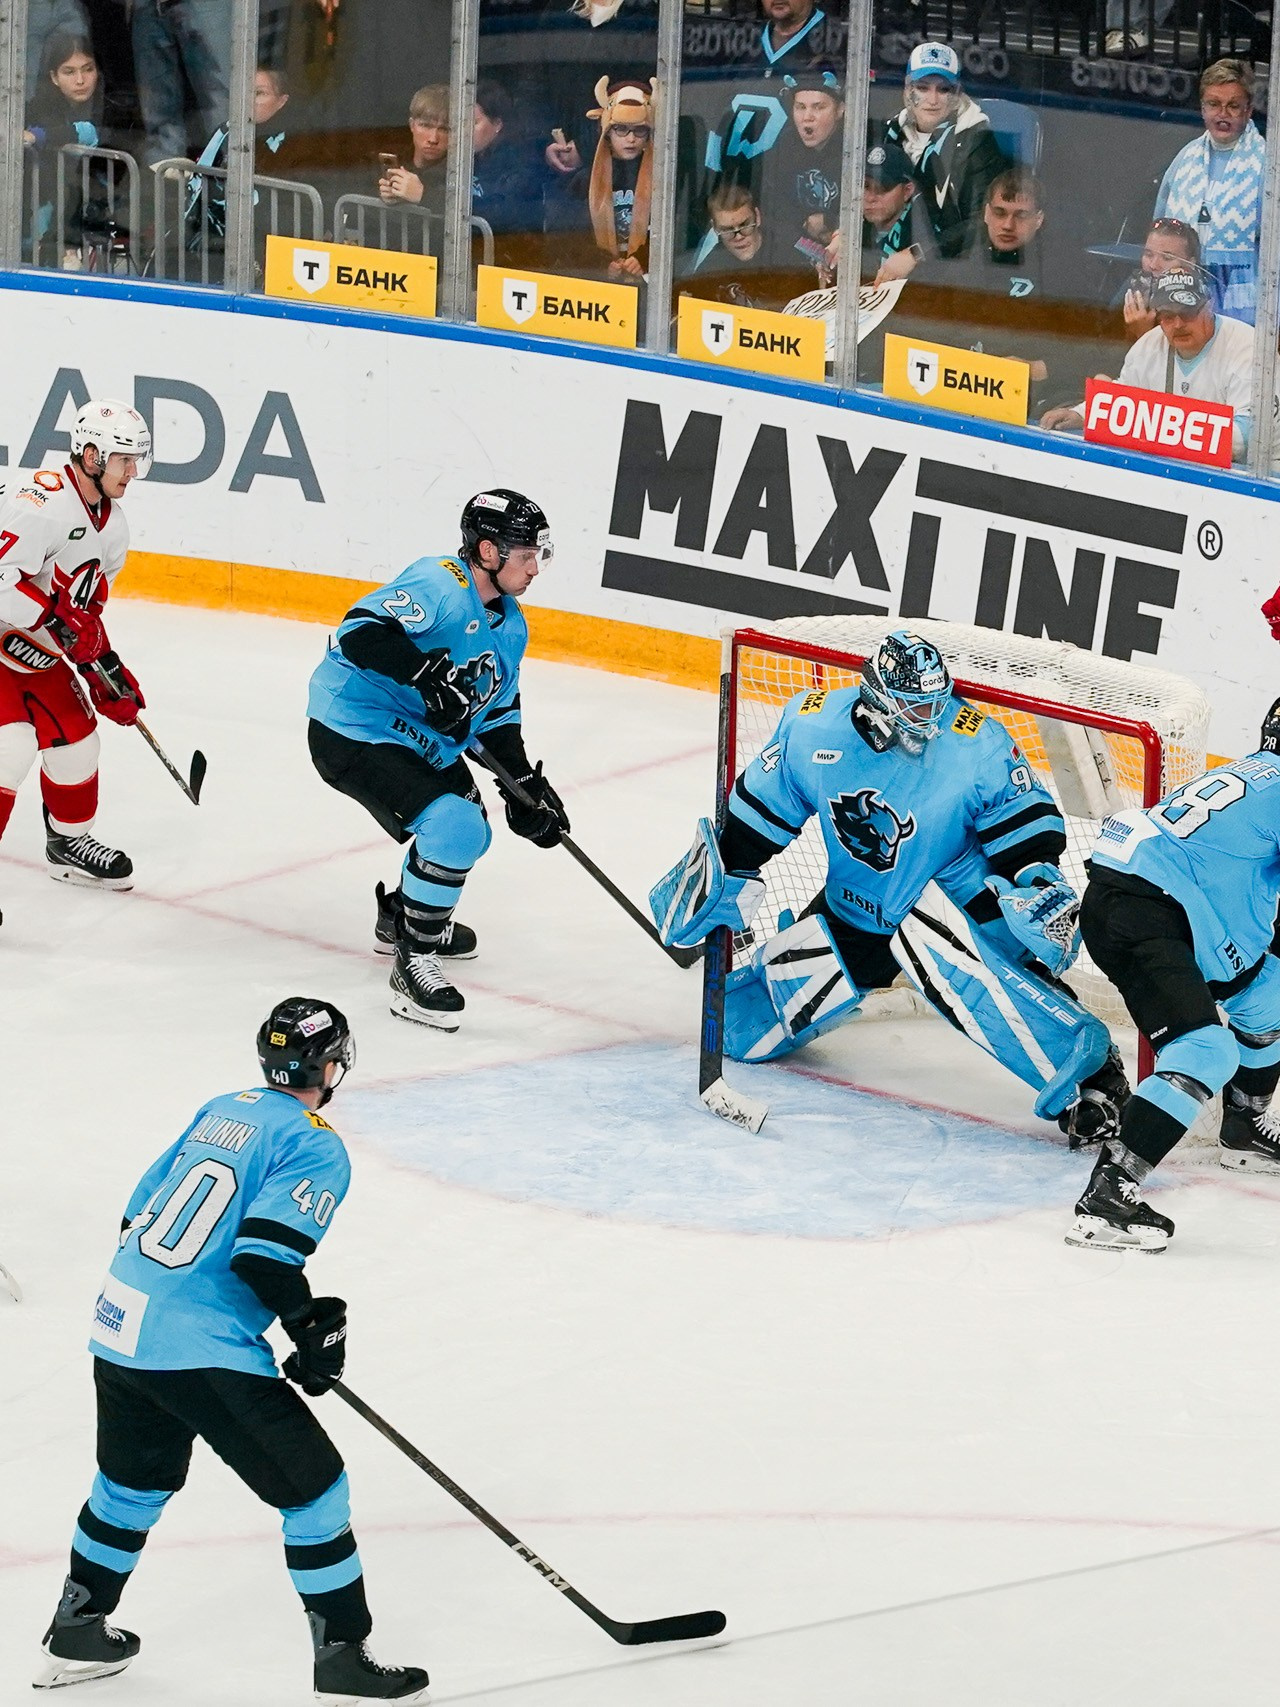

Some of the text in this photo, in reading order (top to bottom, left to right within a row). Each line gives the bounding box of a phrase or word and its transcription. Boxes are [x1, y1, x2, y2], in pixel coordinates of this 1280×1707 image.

[335, 265, 409, 294] БАНК
[542, 296, 610, 324] БАНК
[738, 328, 802, 357] БАНК
[943, 368, 1005, 399] БАНК
[0, 367, 325, 503] ADA
[1086, 391, 1231, 456] FONBET
[382, 590, 426, 630] 22
[954, 707, 973, 730] MAX
[966, 711, 985, 733] LINE
[1002, 966, 1078, 1026] TRUE
[271, 1069, 290, 1085] 40
[290, 1178, 337, 1228] 40
[511, 1542, 571, 1592] CCM
